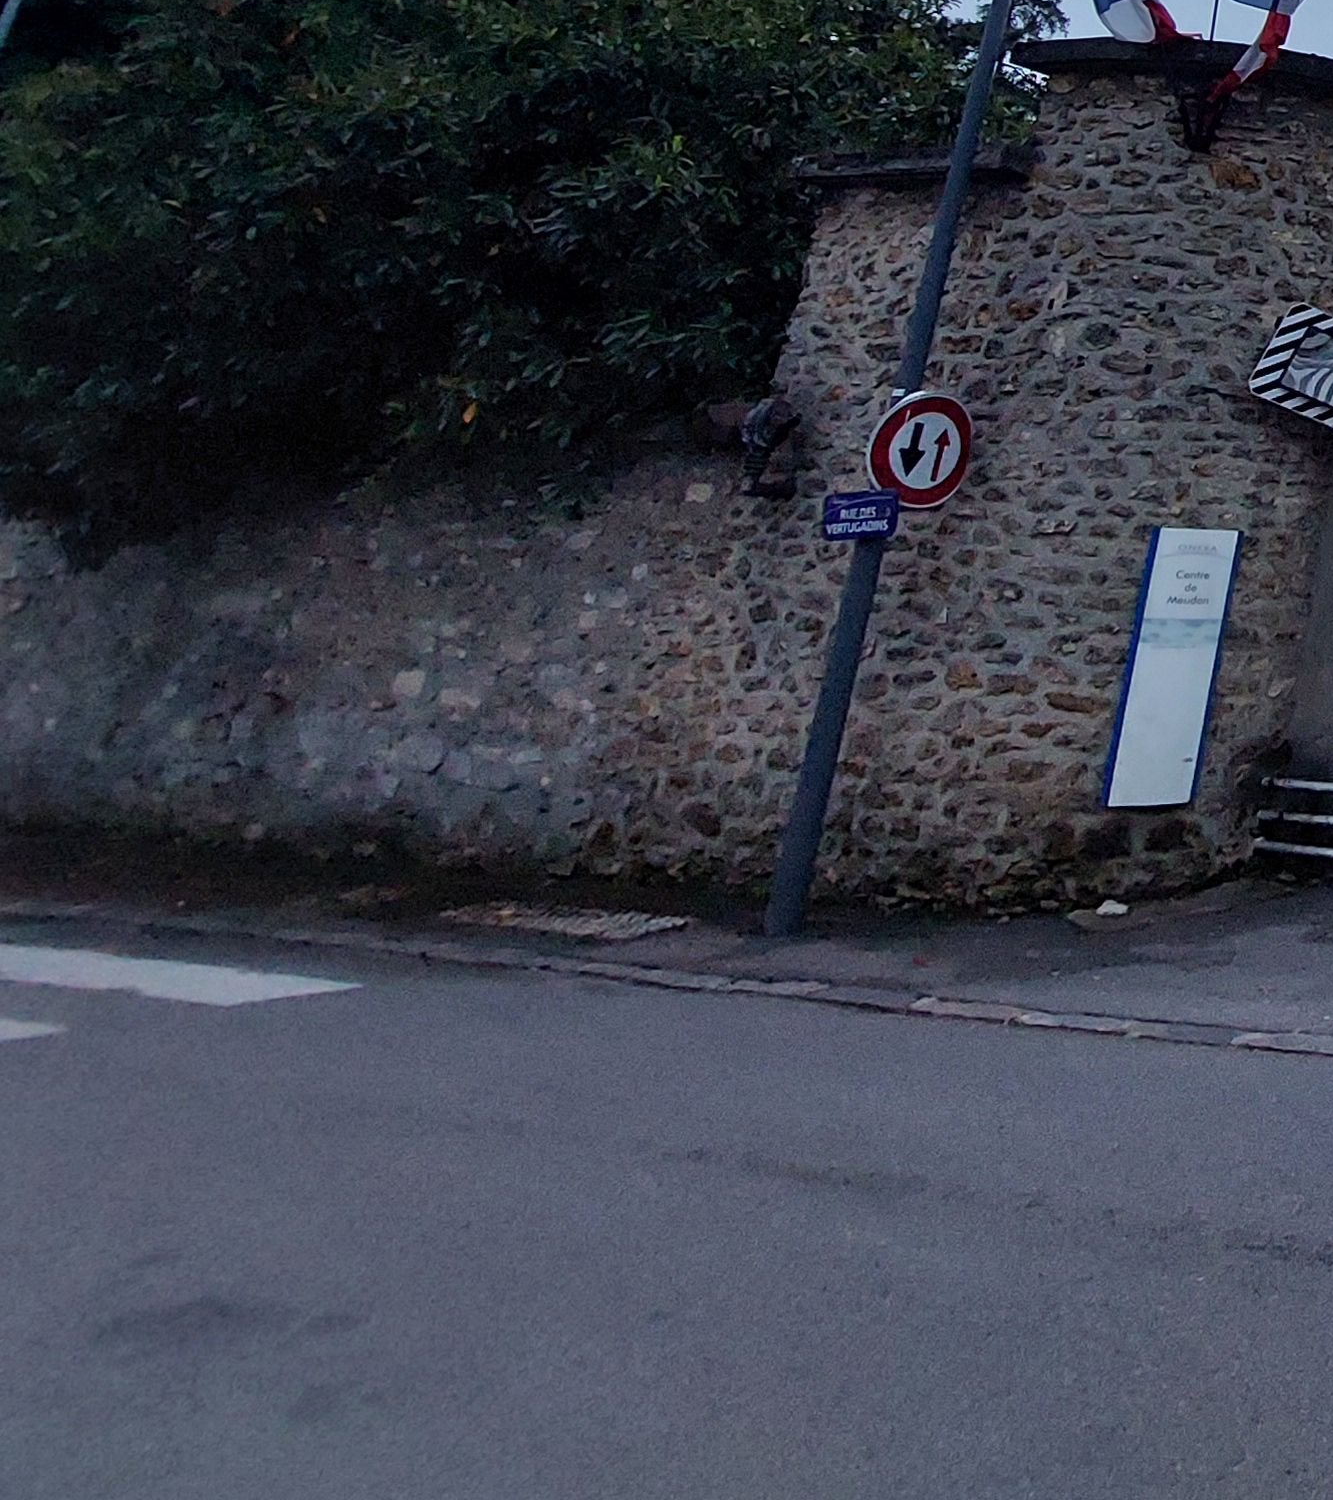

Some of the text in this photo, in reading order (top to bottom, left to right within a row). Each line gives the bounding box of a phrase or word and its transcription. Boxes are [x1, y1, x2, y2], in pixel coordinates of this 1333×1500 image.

[840, 506, 877, 520] RUE DES
[825, 519, 889, 535] VERTUGADINS
[1175, 569, 1210, 580] Centre
[1184, 583, 1198, 593] de
[1166, 595, 1210, 605] Meudon
